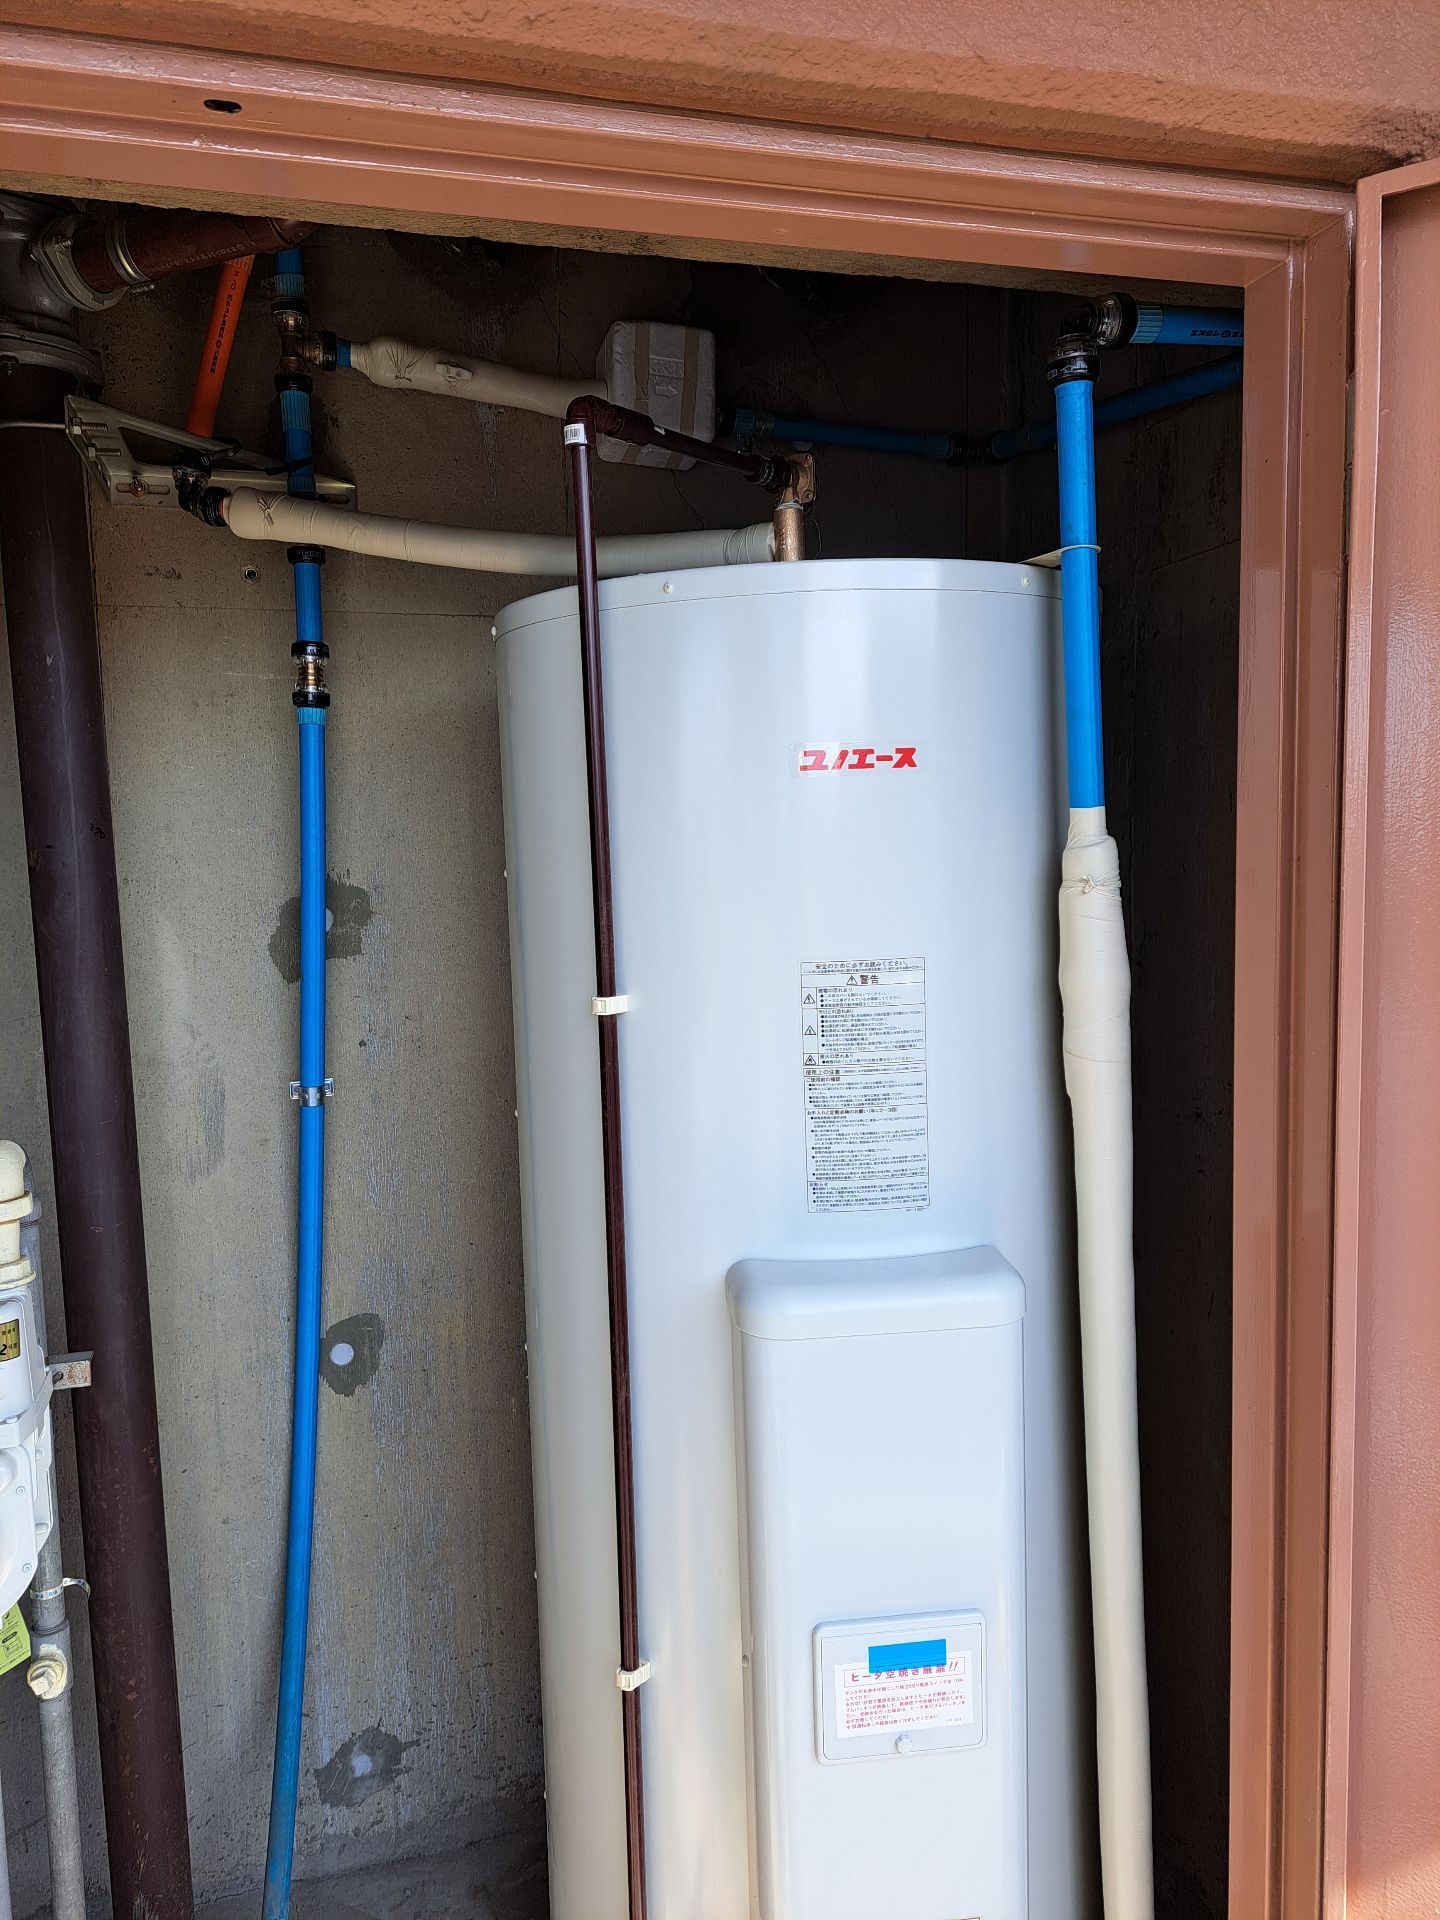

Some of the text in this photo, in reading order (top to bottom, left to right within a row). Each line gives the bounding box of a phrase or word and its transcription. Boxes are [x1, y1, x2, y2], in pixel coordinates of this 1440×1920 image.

[1190, 329, 1220, 337] エスロン
[800, 746, 918, 772] ユノエース
[860, 974, 880, 985] 警告
